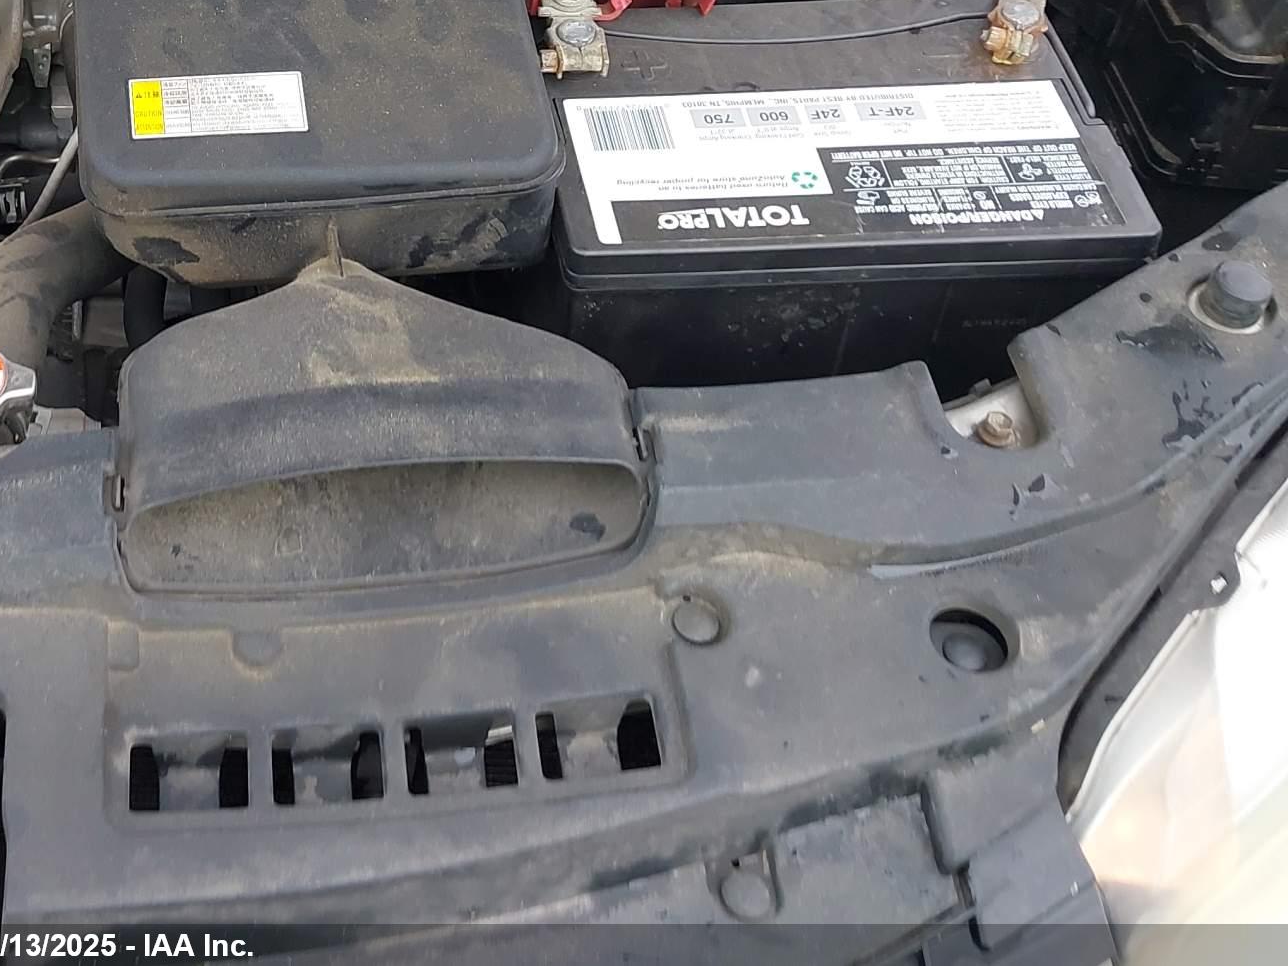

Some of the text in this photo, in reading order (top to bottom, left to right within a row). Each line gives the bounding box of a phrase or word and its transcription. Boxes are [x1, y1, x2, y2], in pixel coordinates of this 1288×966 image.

[810, 108, 841, 119] 24F
[869, 106, 915, 116] 24F-T
[703, 114, 734, 124] 750
[760, 112, 789, 122] 600
[983, 146, 992, 154] OF
[991, 146, 1018, 154] REACH
[1016, 145, 1032, 153] THE
[1044, 144, 1058, 152] OUT
[1058, 143, 1077, 151] KEEP
[862, 151, 880, 159] OPEN
[879, 150, 893, 158] NOT
[662, 177, 693, 185] proper
[1009, 191, 1070, 201] EXPLOSIVE GASES
[888, 204, 906, 212] ACID
[979, 200, 996, 210] NO
[1029, 200, 1074, 209] SHIELD EYES
[875, 205, 889, 213] CAN
[657, 205, 810, 230] TOTALPRO
